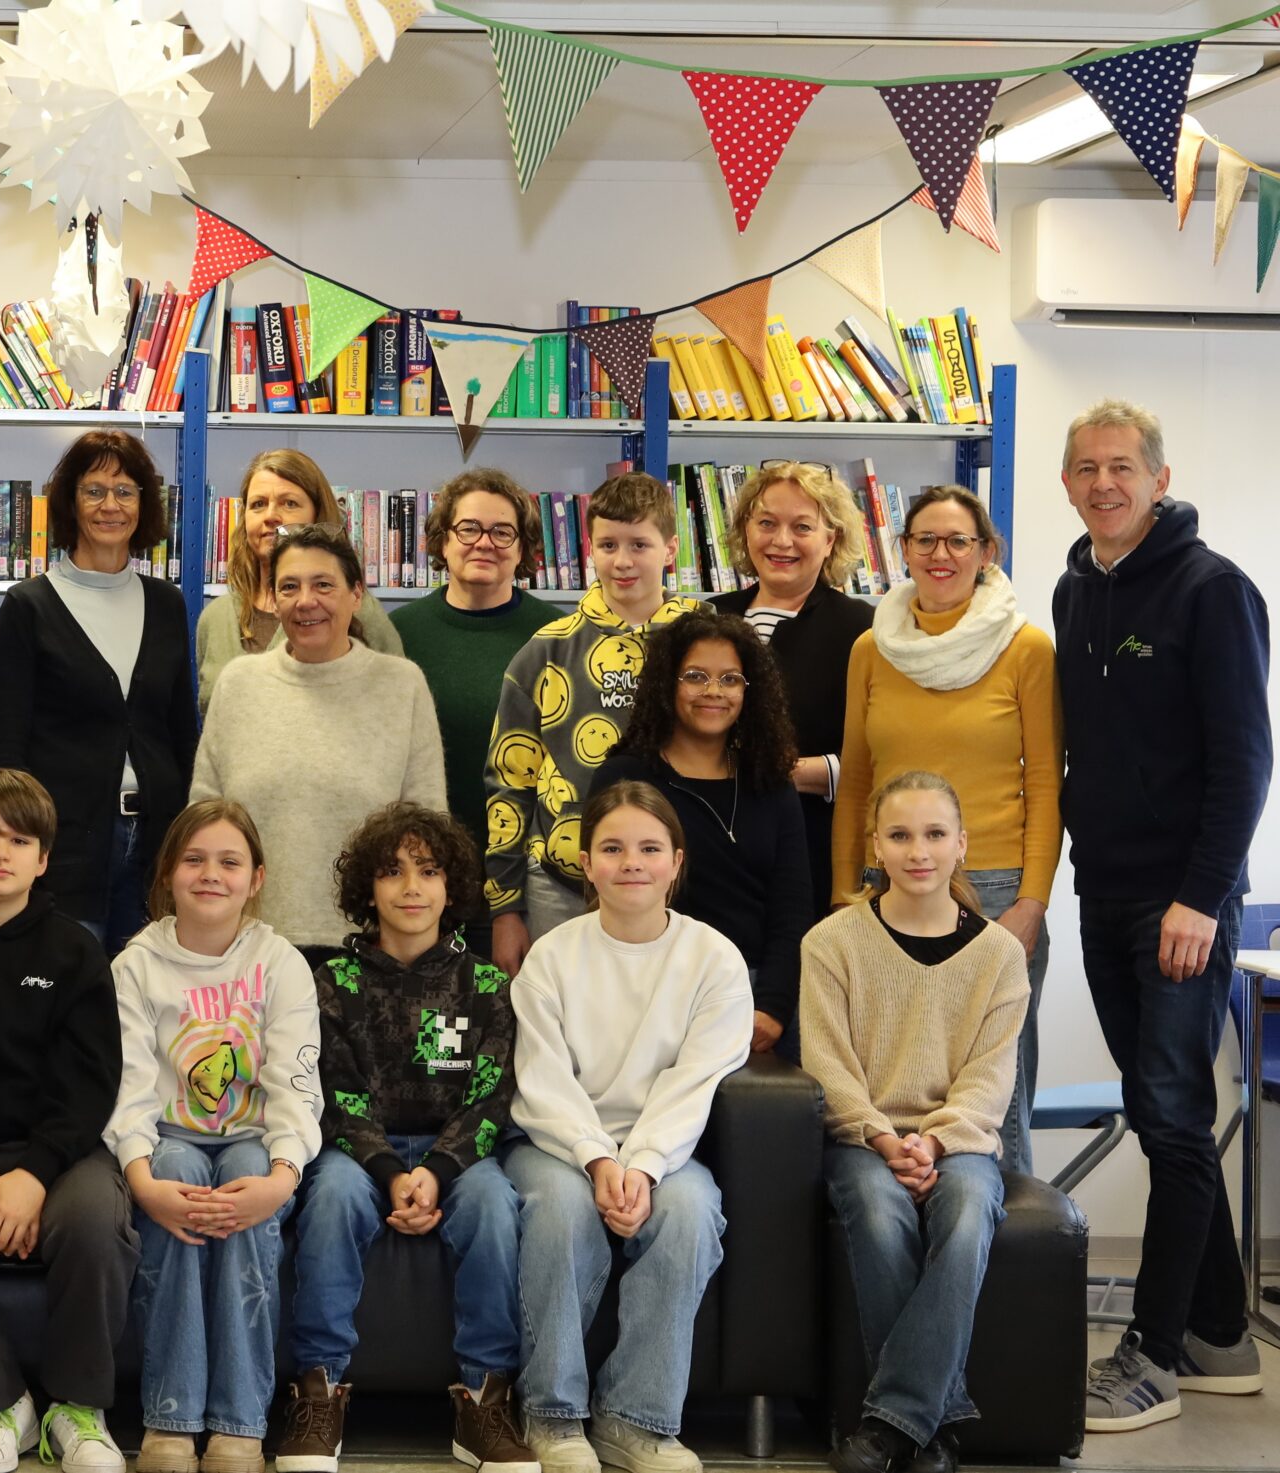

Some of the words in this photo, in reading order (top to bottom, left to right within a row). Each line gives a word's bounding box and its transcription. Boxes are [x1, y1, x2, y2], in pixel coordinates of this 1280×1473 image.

[262, 310, 271, 339] Advanced
[269, 309, 286, 365] OXFORD
[294, 319, 305, 357] Lexikon
[352, 349, 360, 392] Dictionary
[384, 329, 397, 374] Oxford
[601, 669, 637, 690] SMIL
[428, 1059, 472, 1071] MINECRAFT
